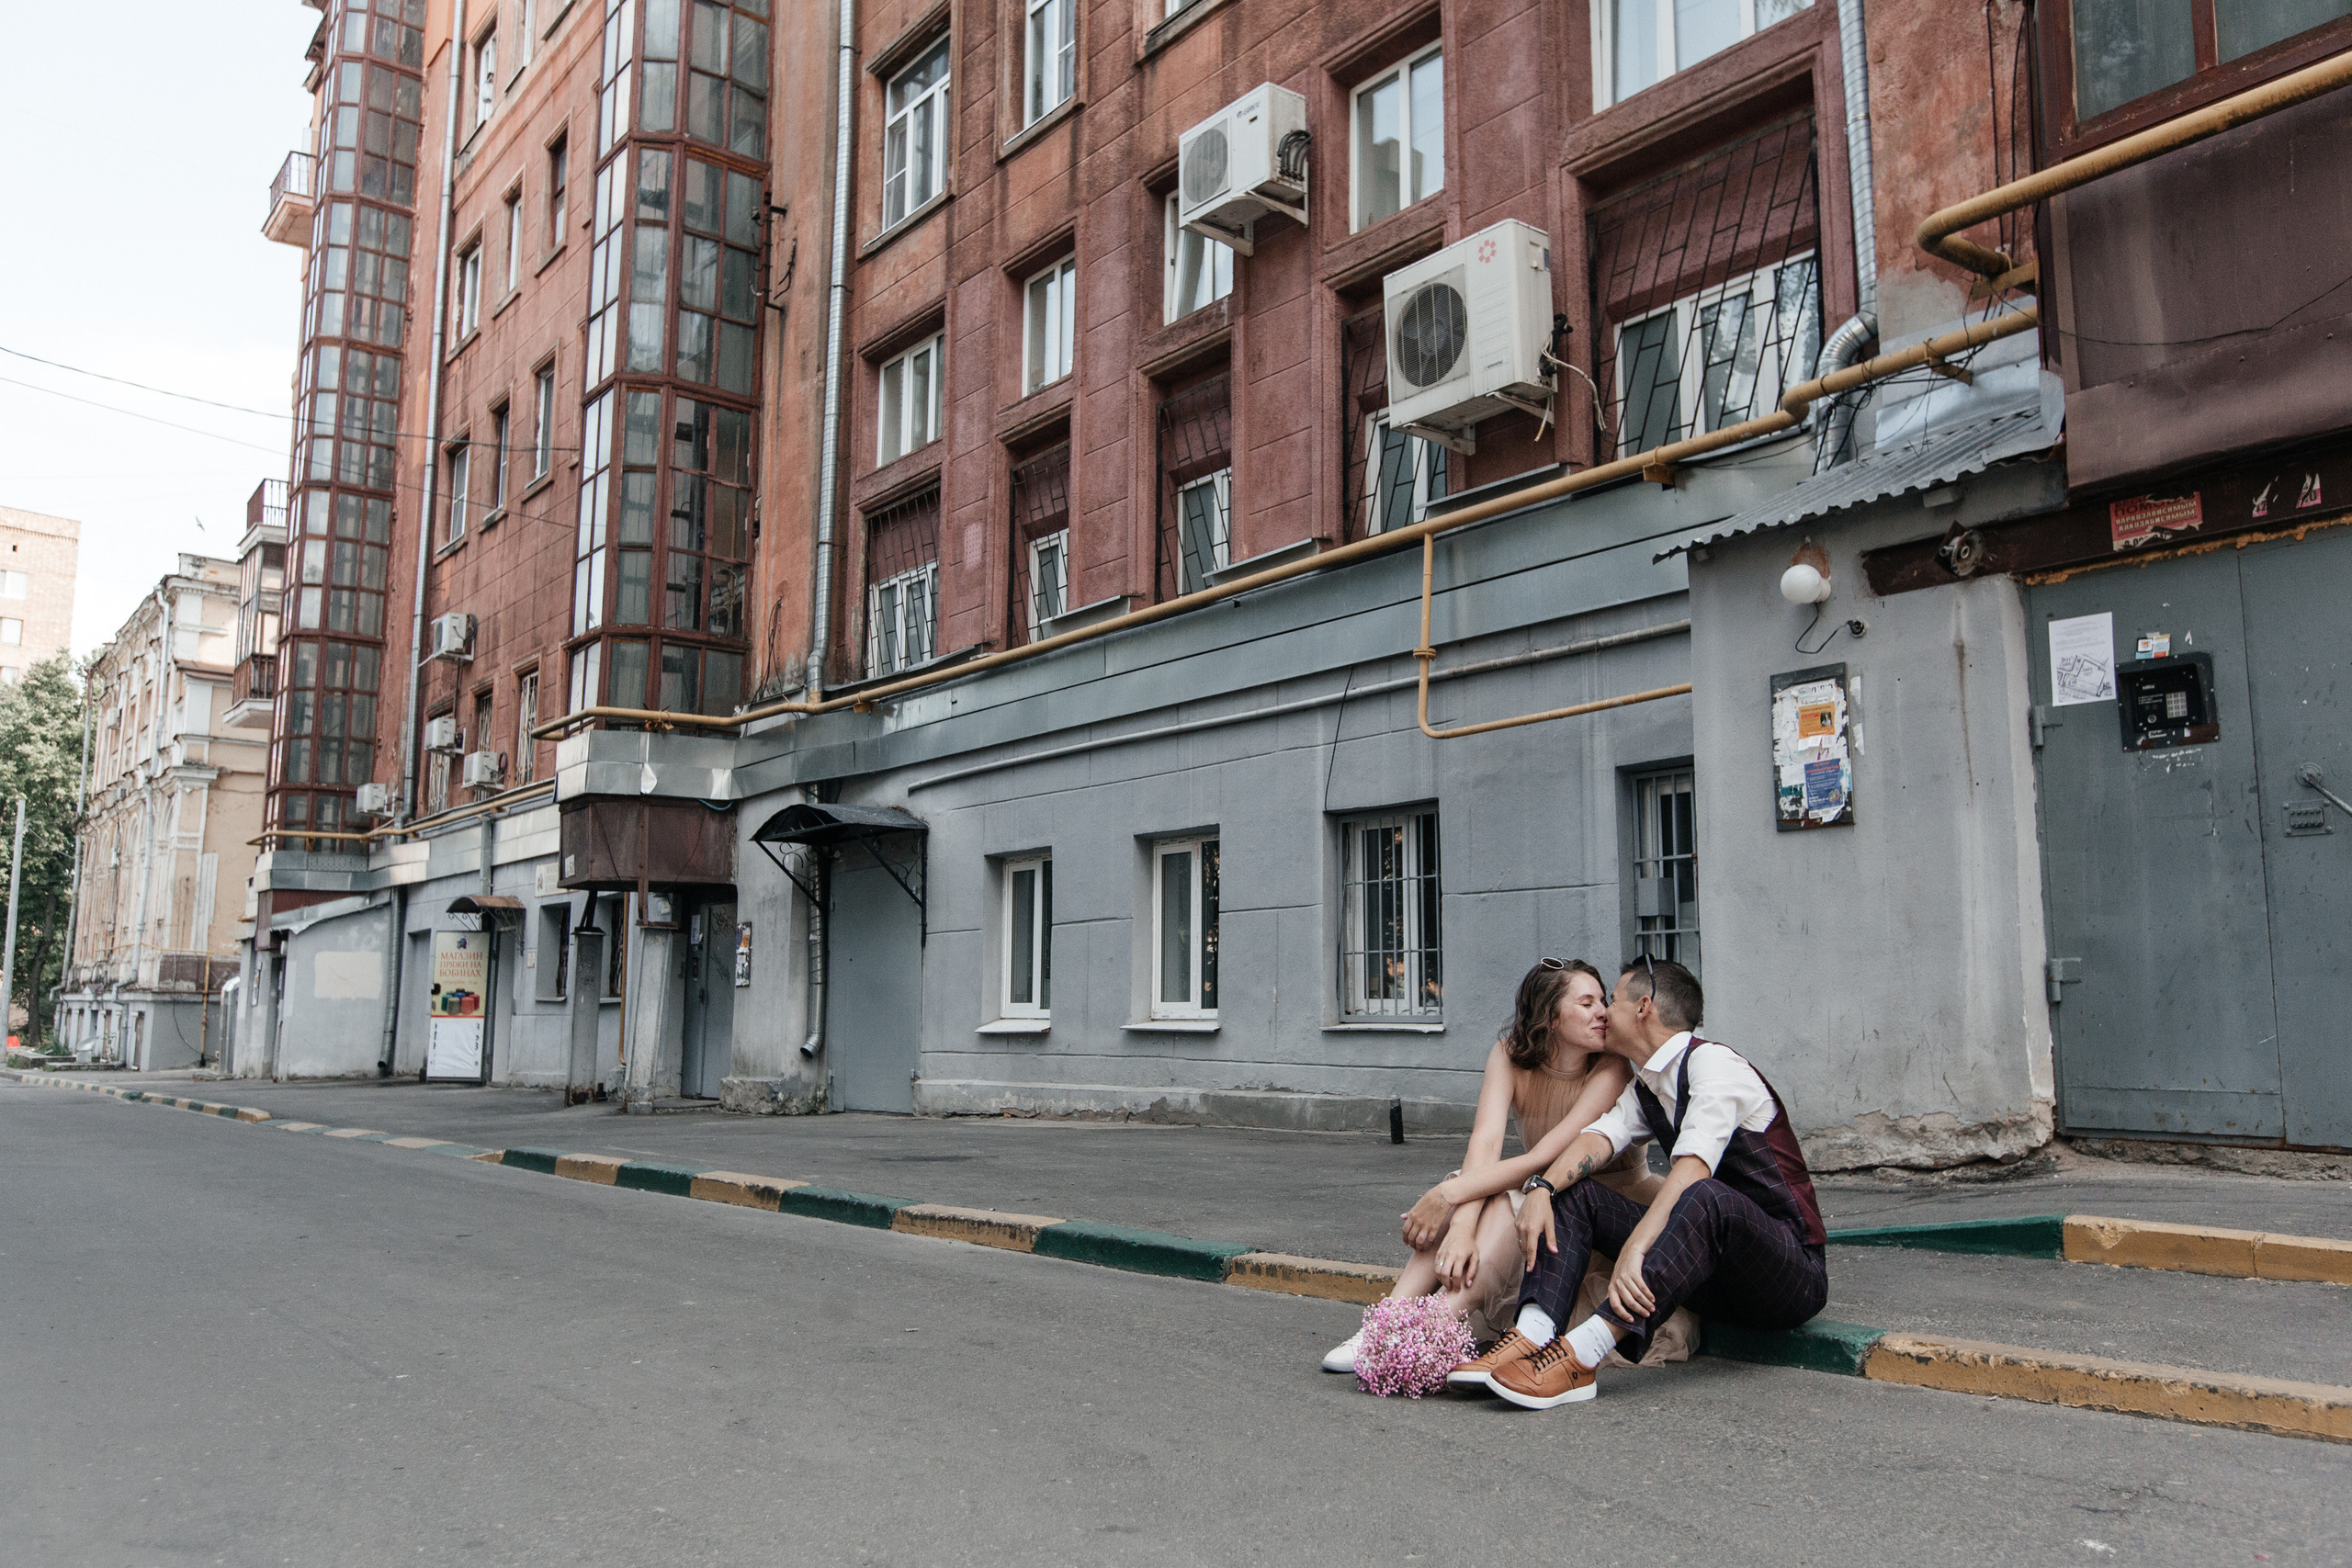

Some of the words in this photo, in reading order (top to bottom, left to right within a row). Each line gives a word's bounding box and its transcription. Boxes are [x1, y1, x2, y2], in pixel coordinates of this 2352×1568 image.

[2115, 501, 2197, 525] НАРКОЗАВИСИМЫМ
[2119, 509, 2195, 532] АЛКОЗАВИСИМЫМ
[441, 952, 483, 960] МАГАЗИН
[439, 969, 481, 977] БОБИНАХ
